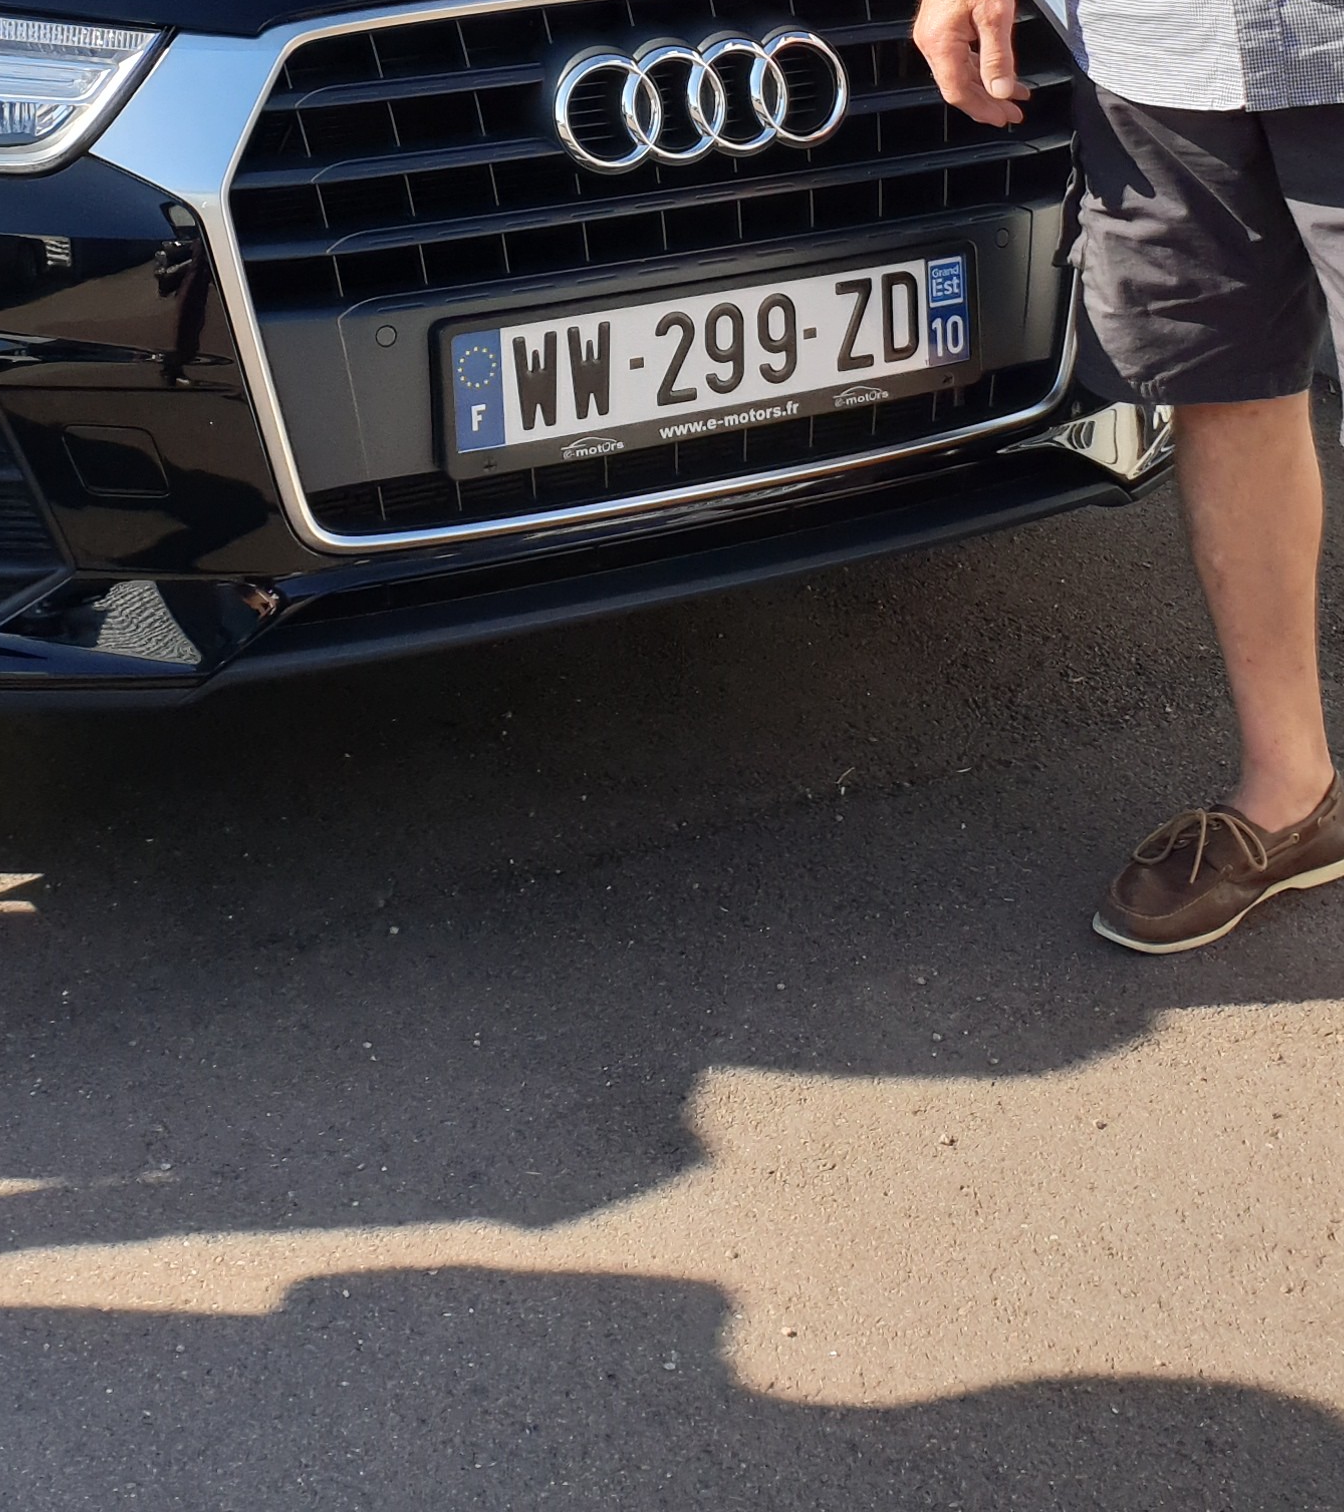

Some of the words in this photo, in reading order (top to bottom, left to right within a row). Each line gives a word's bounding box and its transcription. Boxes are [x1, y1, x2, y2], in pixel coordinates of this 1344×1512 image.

[931, 264, 960, 278] Grand
[931, 276, 961, 298] Est
[470, 404, 487, 432] F
[931, 315, 964, 357] 10
[659, 400, 800, 439] www.e-motors.fr
